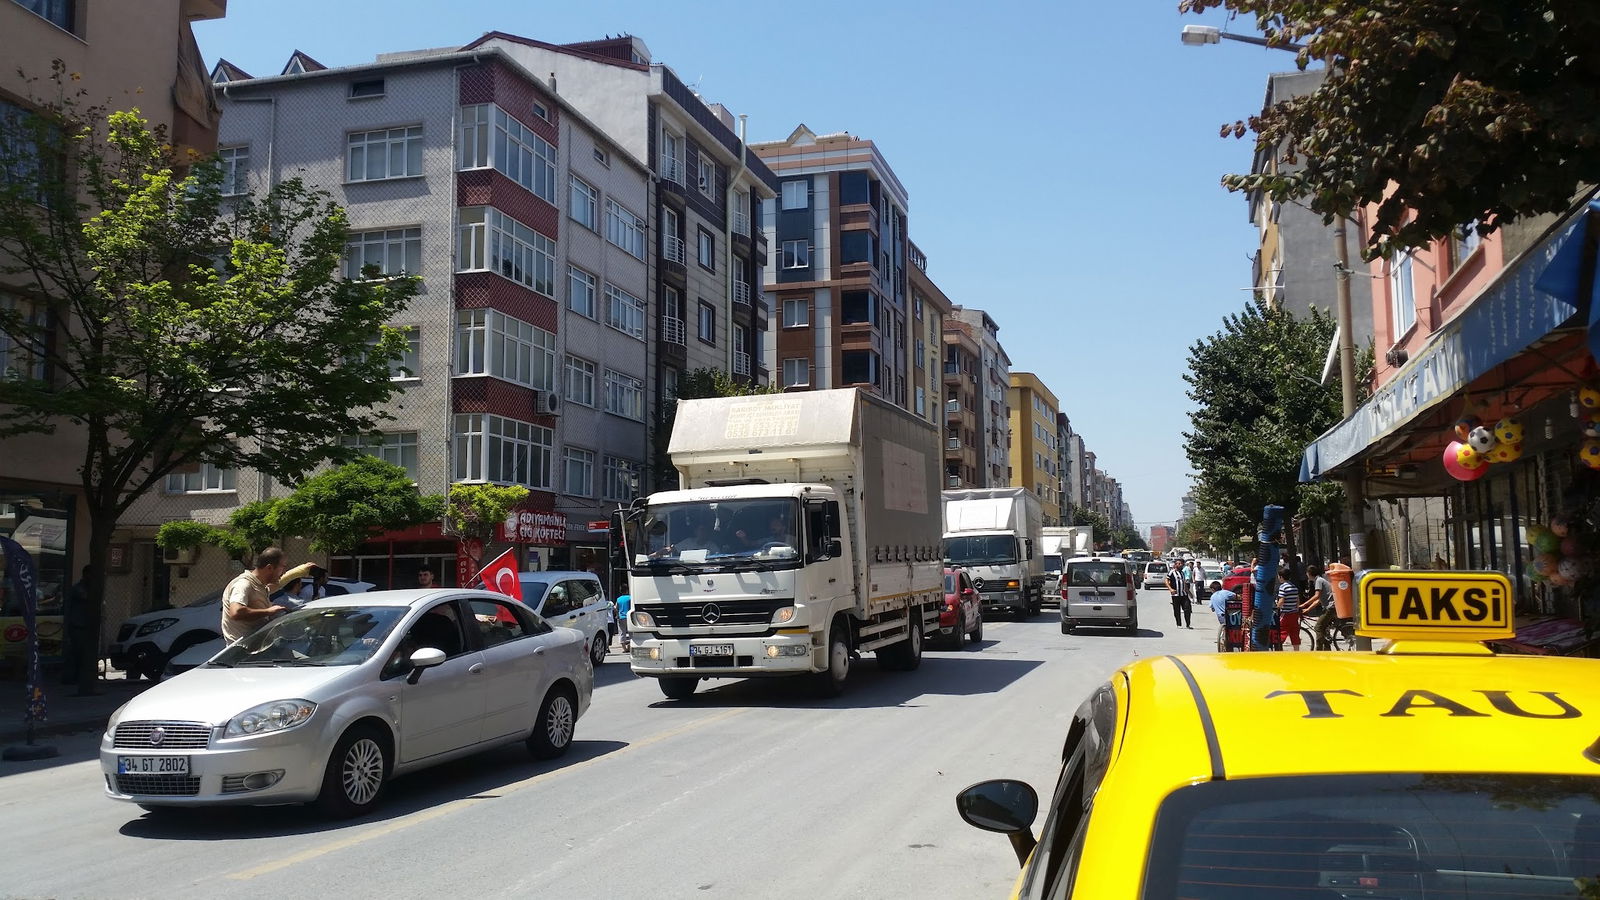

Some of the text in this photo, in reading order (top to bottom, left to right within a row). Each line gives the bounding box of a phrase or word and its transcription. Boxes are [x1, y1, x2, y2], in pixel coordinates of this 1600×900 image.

[694, 646, 702, 654] 34
[125, 758, 186, 772] 34 GT 2802
